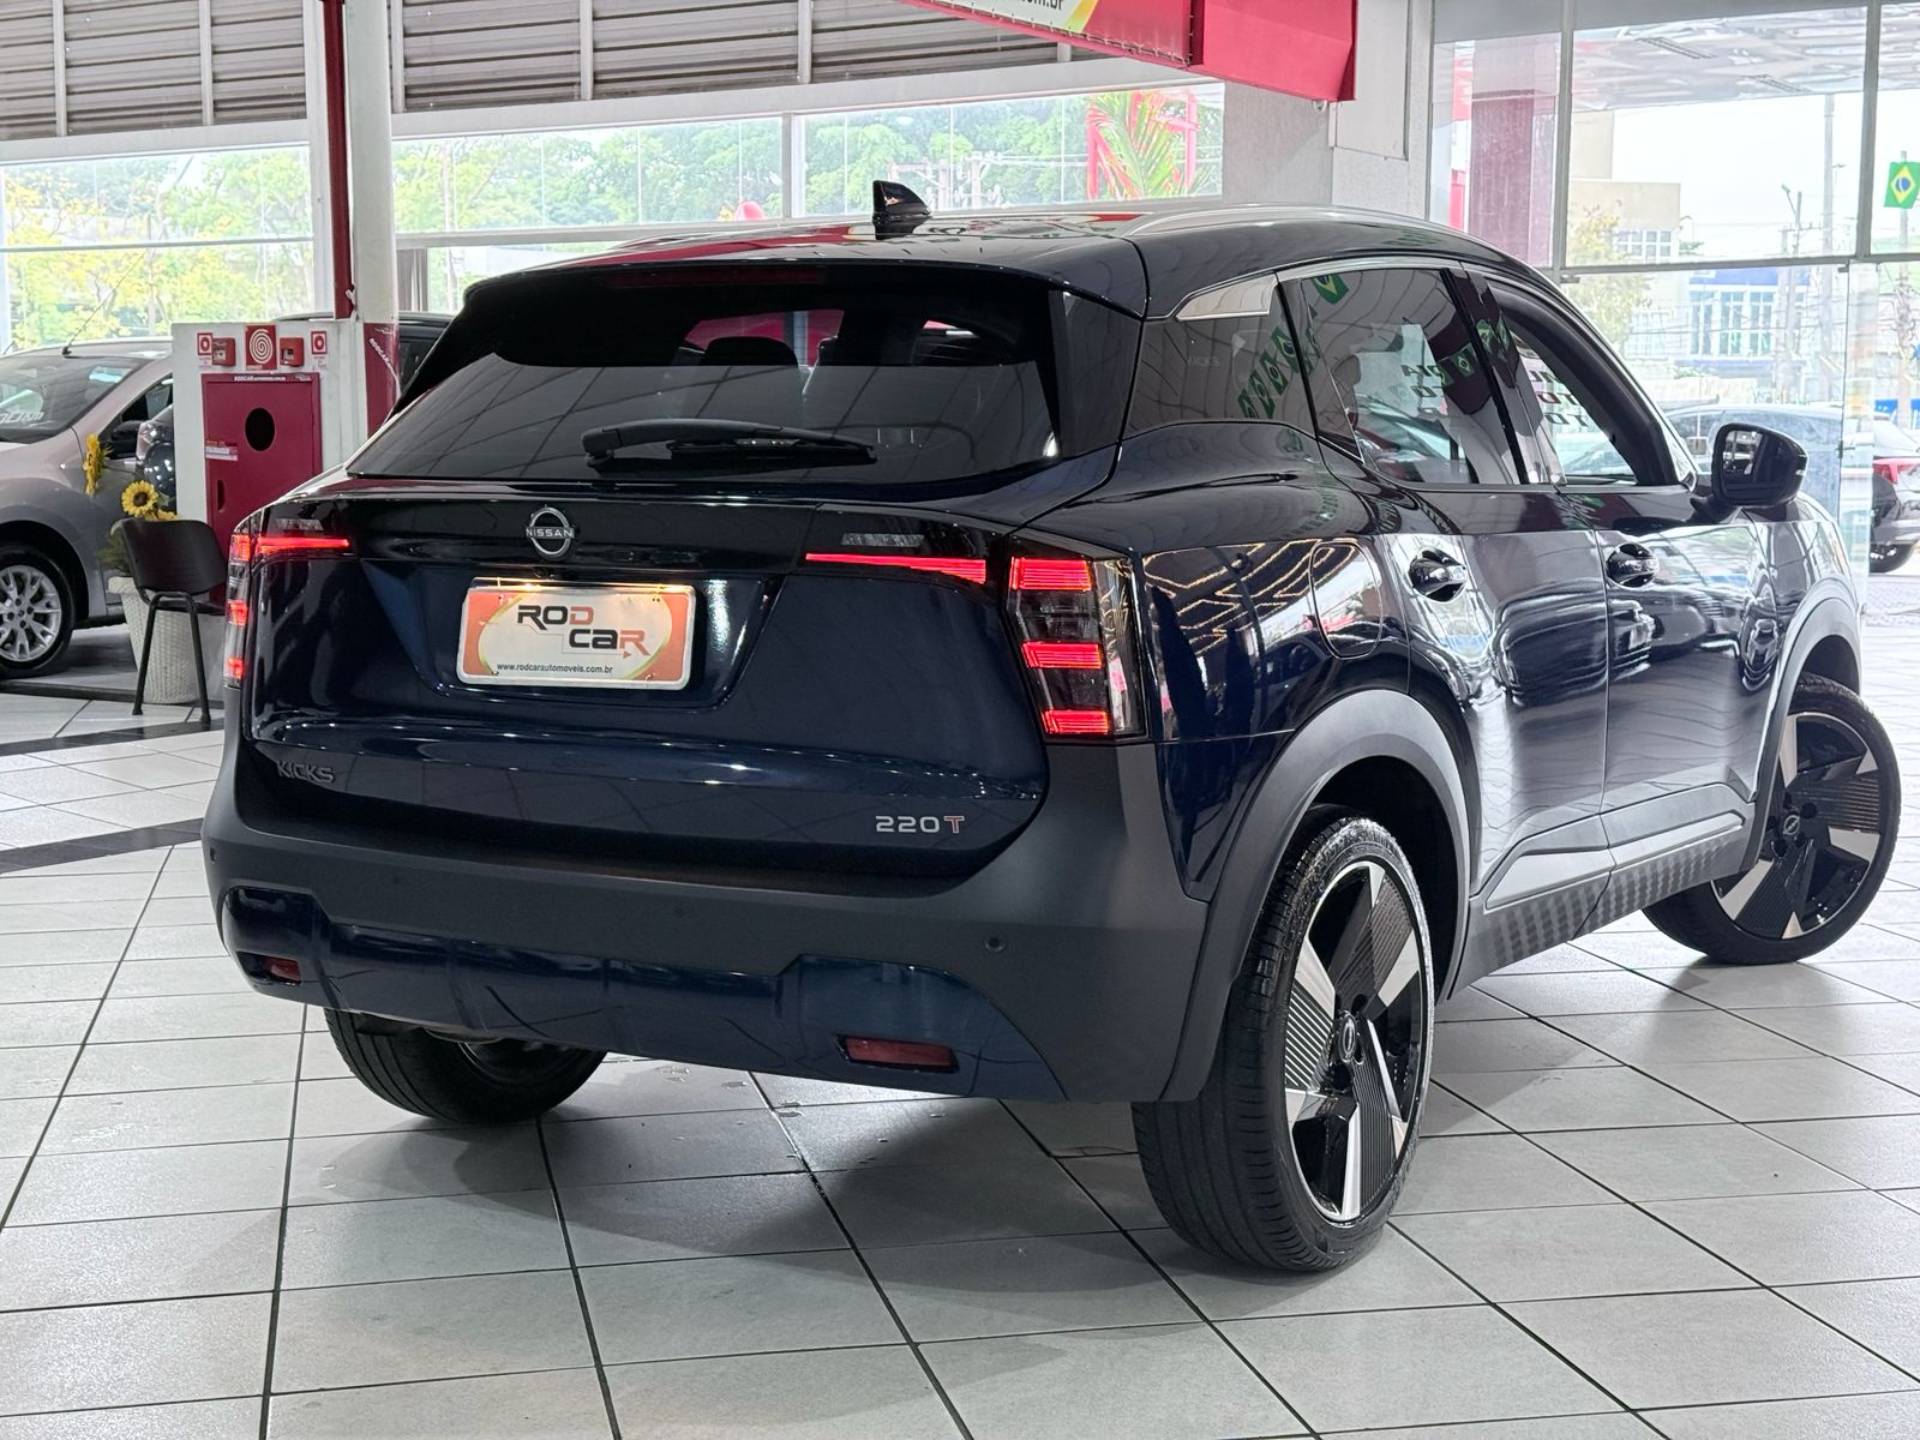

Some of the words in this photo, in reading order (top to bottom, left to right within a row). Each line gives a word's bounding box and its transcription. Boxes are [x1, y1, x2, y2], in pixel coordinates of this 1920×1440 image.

[526, 528, 573, 538] NISSAN
[517, 605, 594, 630] ROD
[497, 663, 613, 673] www.rodcarautomoveis.com.br
[277, 760, 334, 782] KICKS
